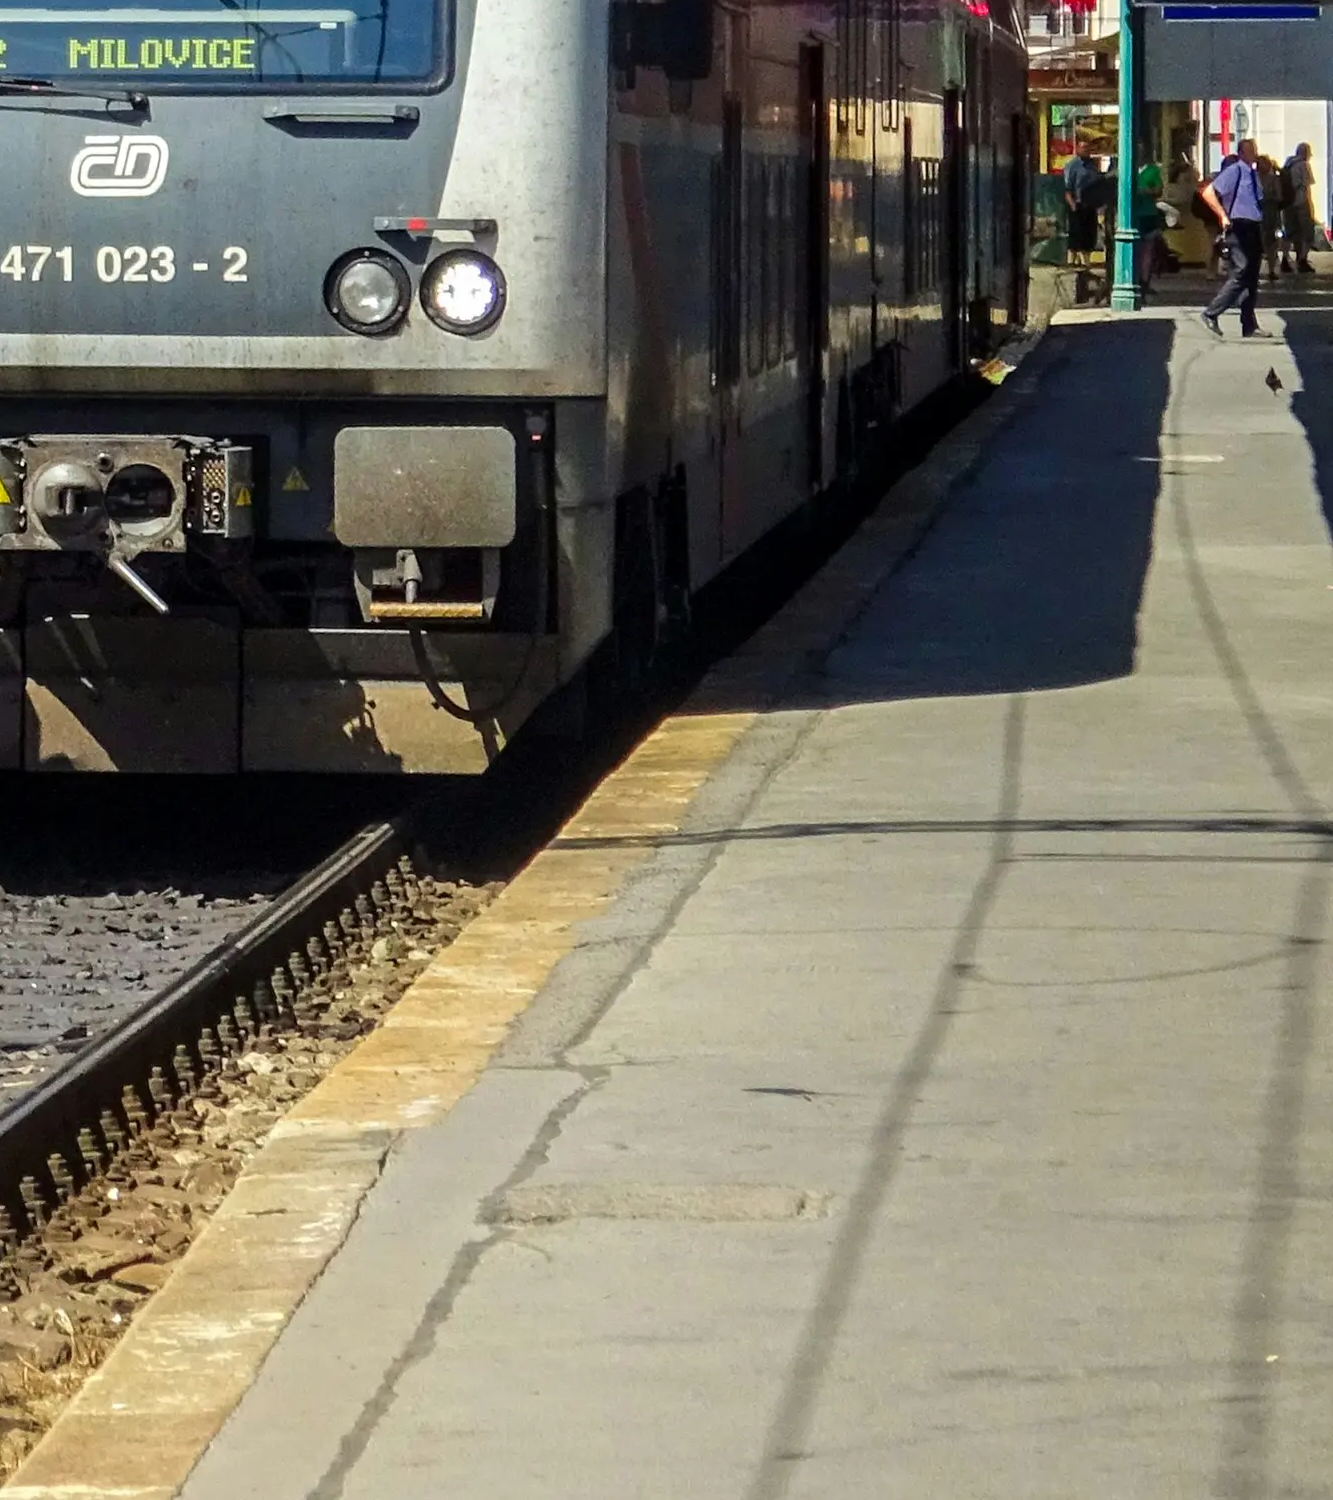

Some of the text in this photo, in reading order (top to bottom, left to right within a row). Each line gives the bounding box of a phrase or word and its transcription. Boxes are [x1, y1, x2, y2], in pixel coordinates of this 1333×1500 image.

[68, 38, 256, 69] MILOVICE
[0, 245, 73, 283] 471
[96, 245, 176, 283] 023
